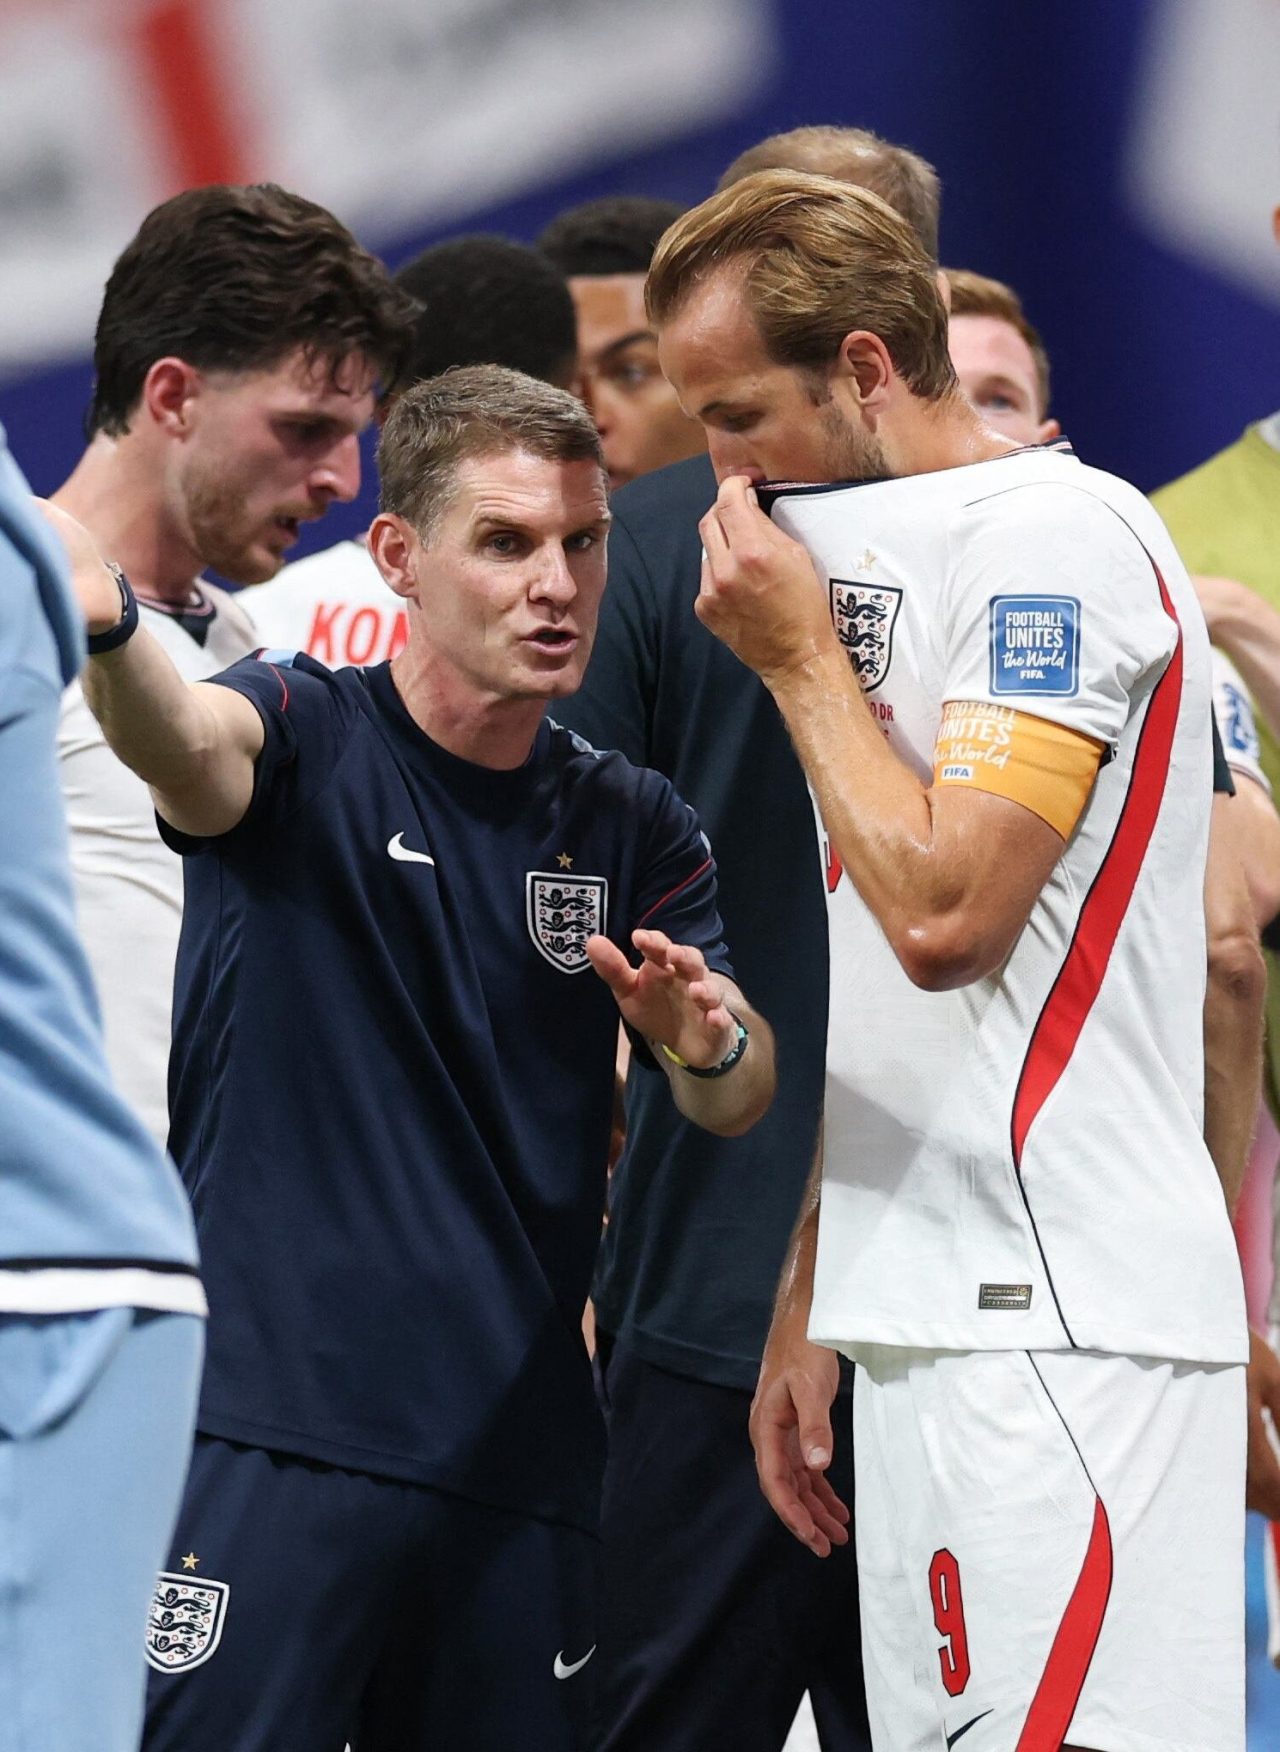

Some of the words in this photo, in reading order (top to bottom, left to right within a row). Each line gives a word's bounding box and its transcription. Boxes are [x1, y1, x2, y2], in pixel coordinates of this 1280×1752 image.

[1005, 611, 1064, 628] FOOTBALL
[1005, 627, 1064, 649] UNITES
[1001, 650, 1024, 669] the
[1026, 649, 1067, 670] World
[1020, 670, 1046, 680] FIFA
[943, 767, 970, 777] FIFA
[928, 1548, 971, 1698] 9
